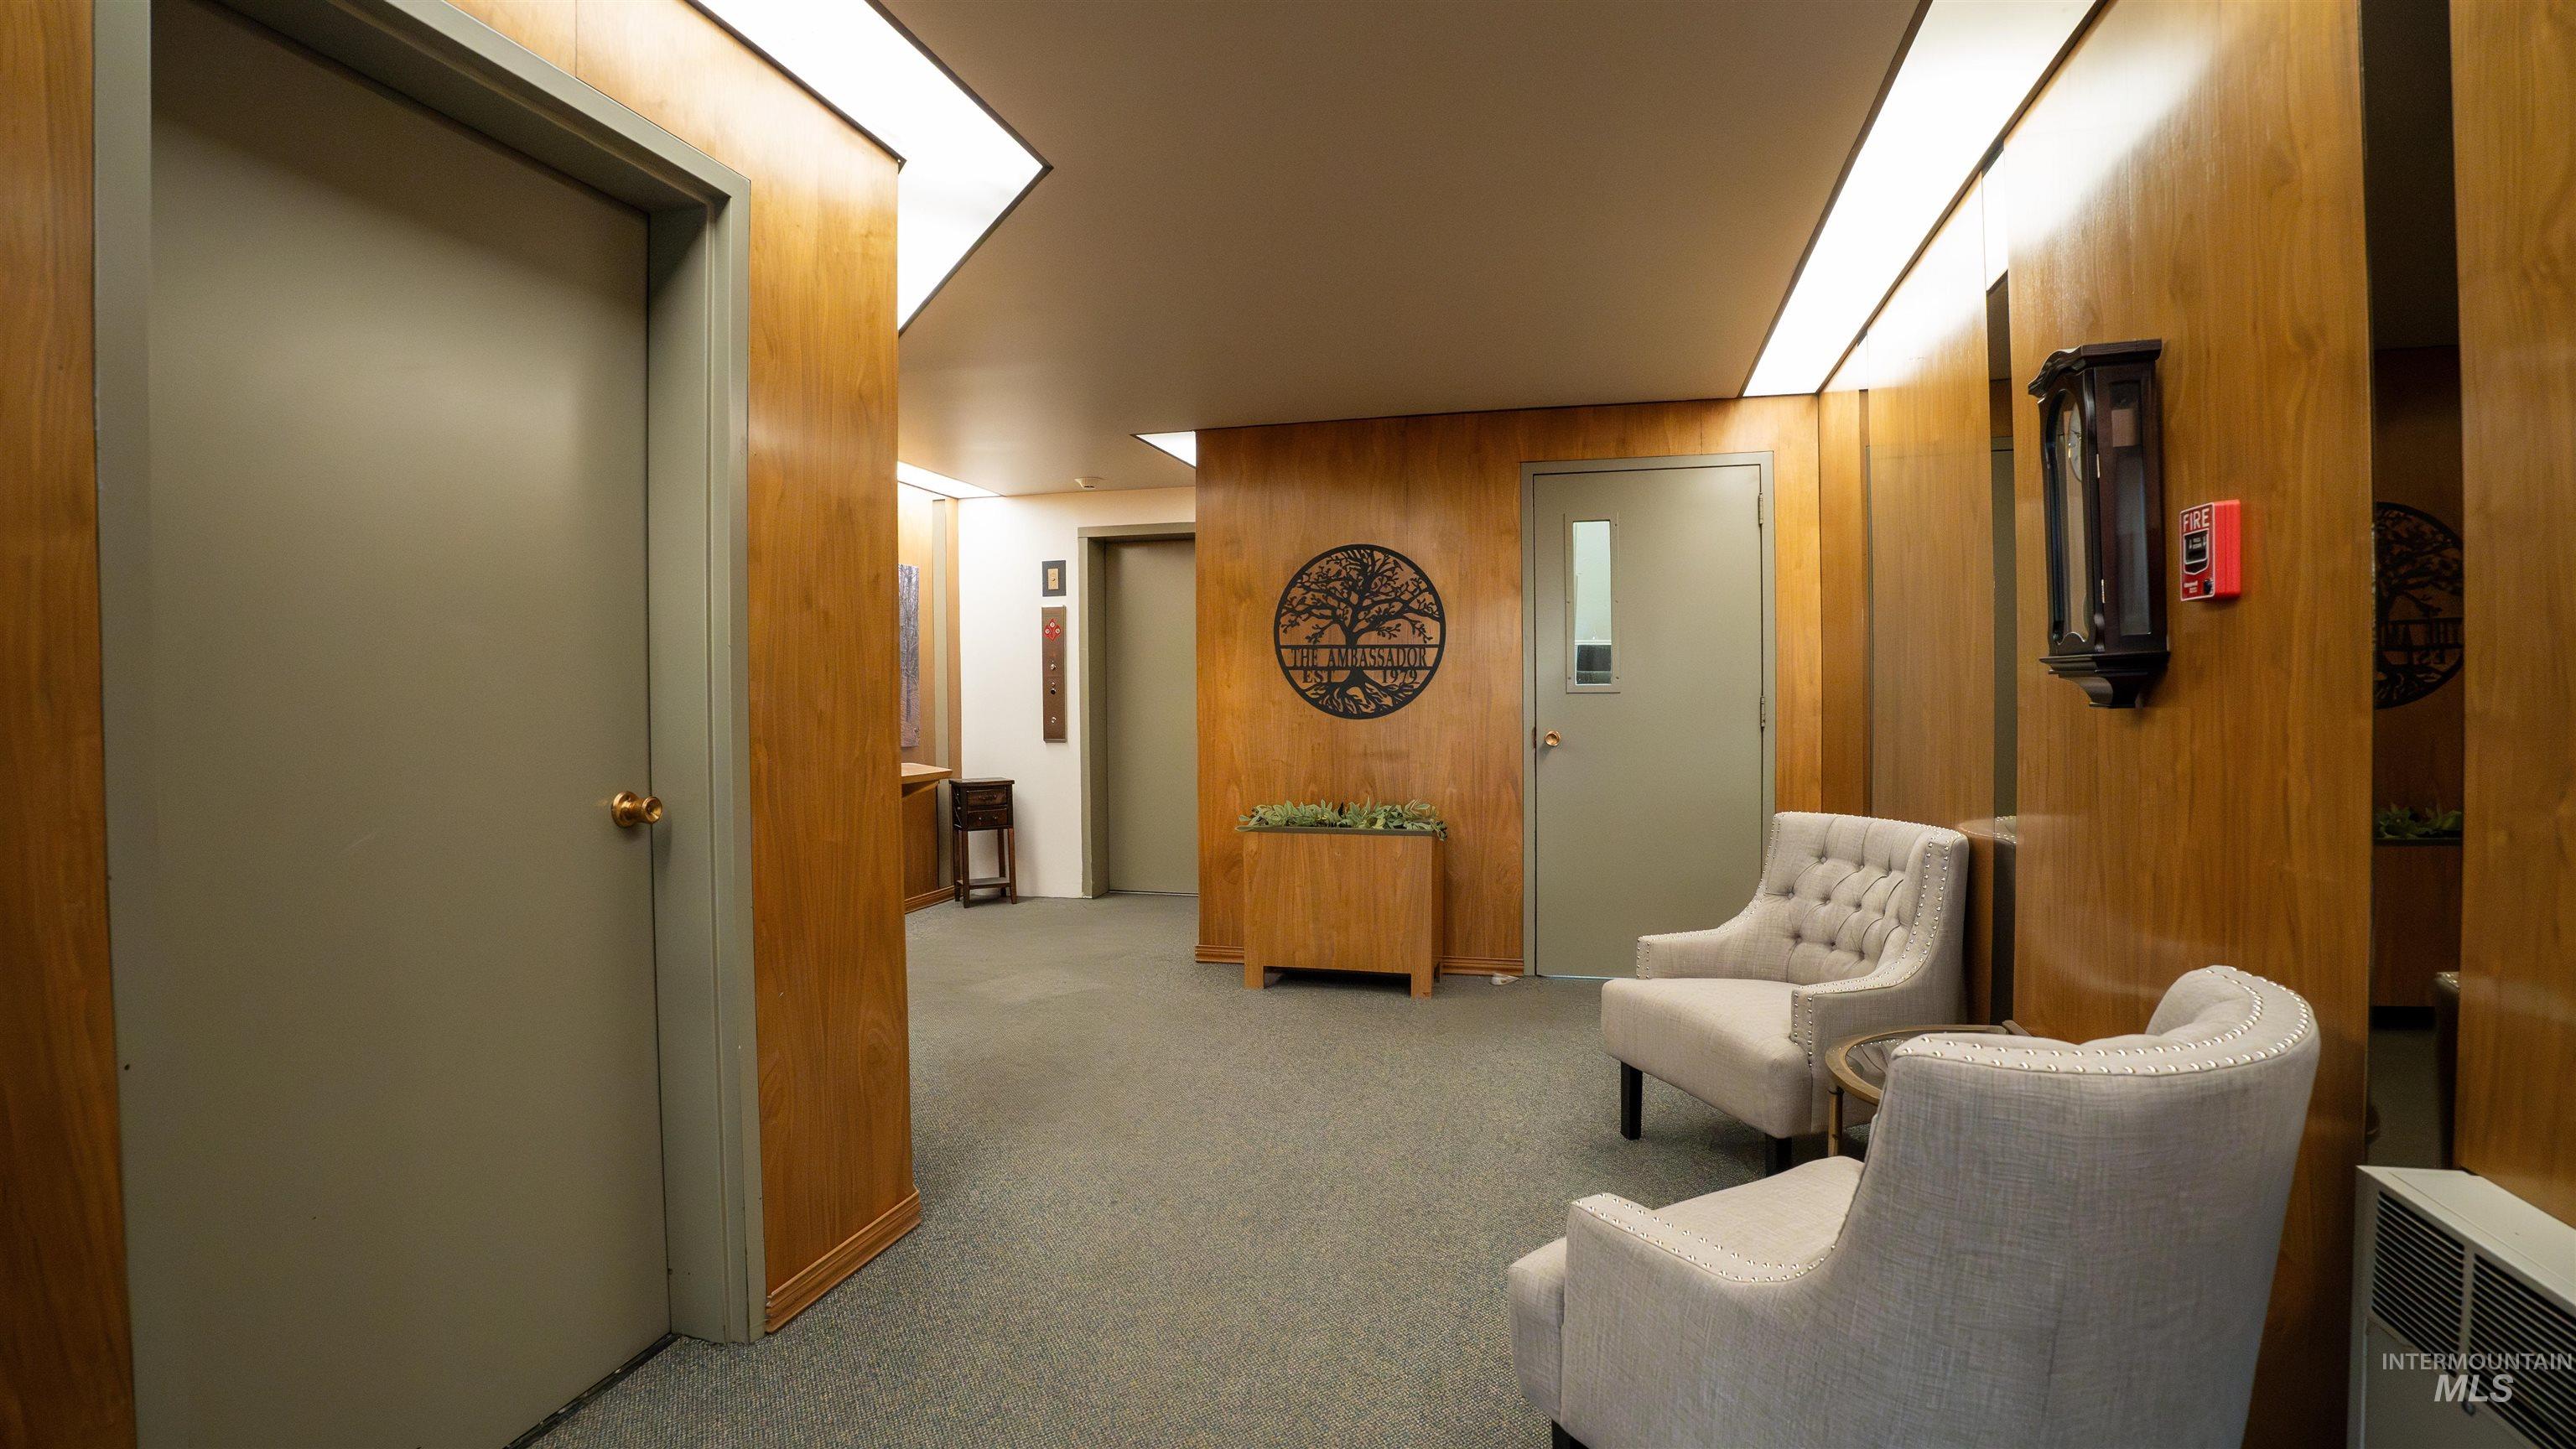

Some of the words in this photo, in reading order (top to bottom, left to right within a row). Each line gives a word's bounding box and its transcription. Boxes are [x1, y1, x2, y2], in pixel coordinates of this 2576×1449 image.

[2183, 507, 2210, 532] FIRE
[1291, 647, 1318, 667] THE
[1327, 647, 1426, 667] AMBASSADOR
[1302, 669, 1336, 683] EST
[1382, 669, 1420, 684] 1972
